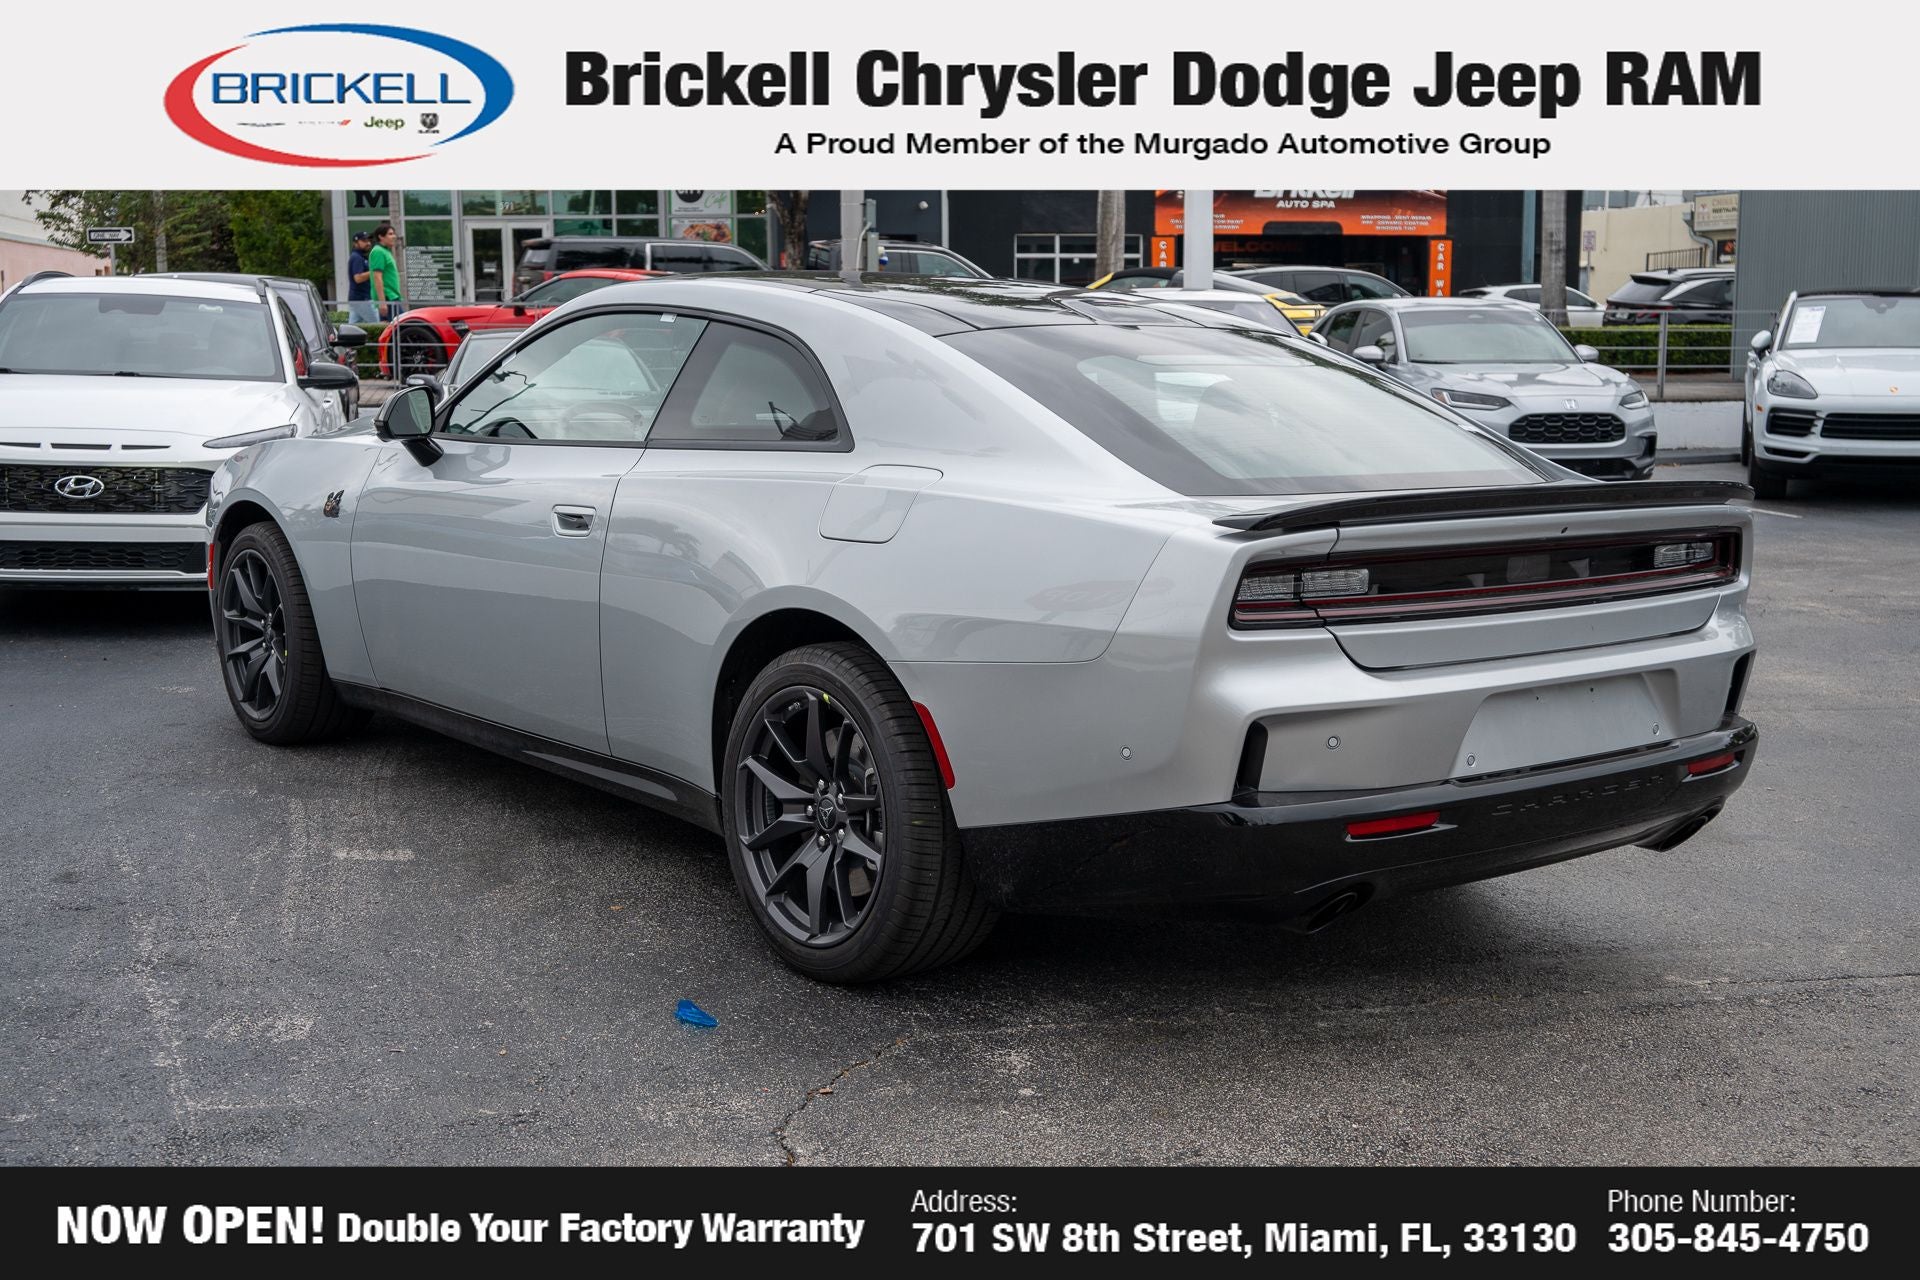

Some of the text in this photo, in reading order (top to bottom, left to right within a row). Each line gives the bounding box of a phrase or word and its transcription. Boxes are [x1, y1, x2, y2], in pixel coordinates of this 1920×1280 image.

[1276, 199, 1336, 209] AUTO SPA
[1436, 242, 1446, 271] CAR
